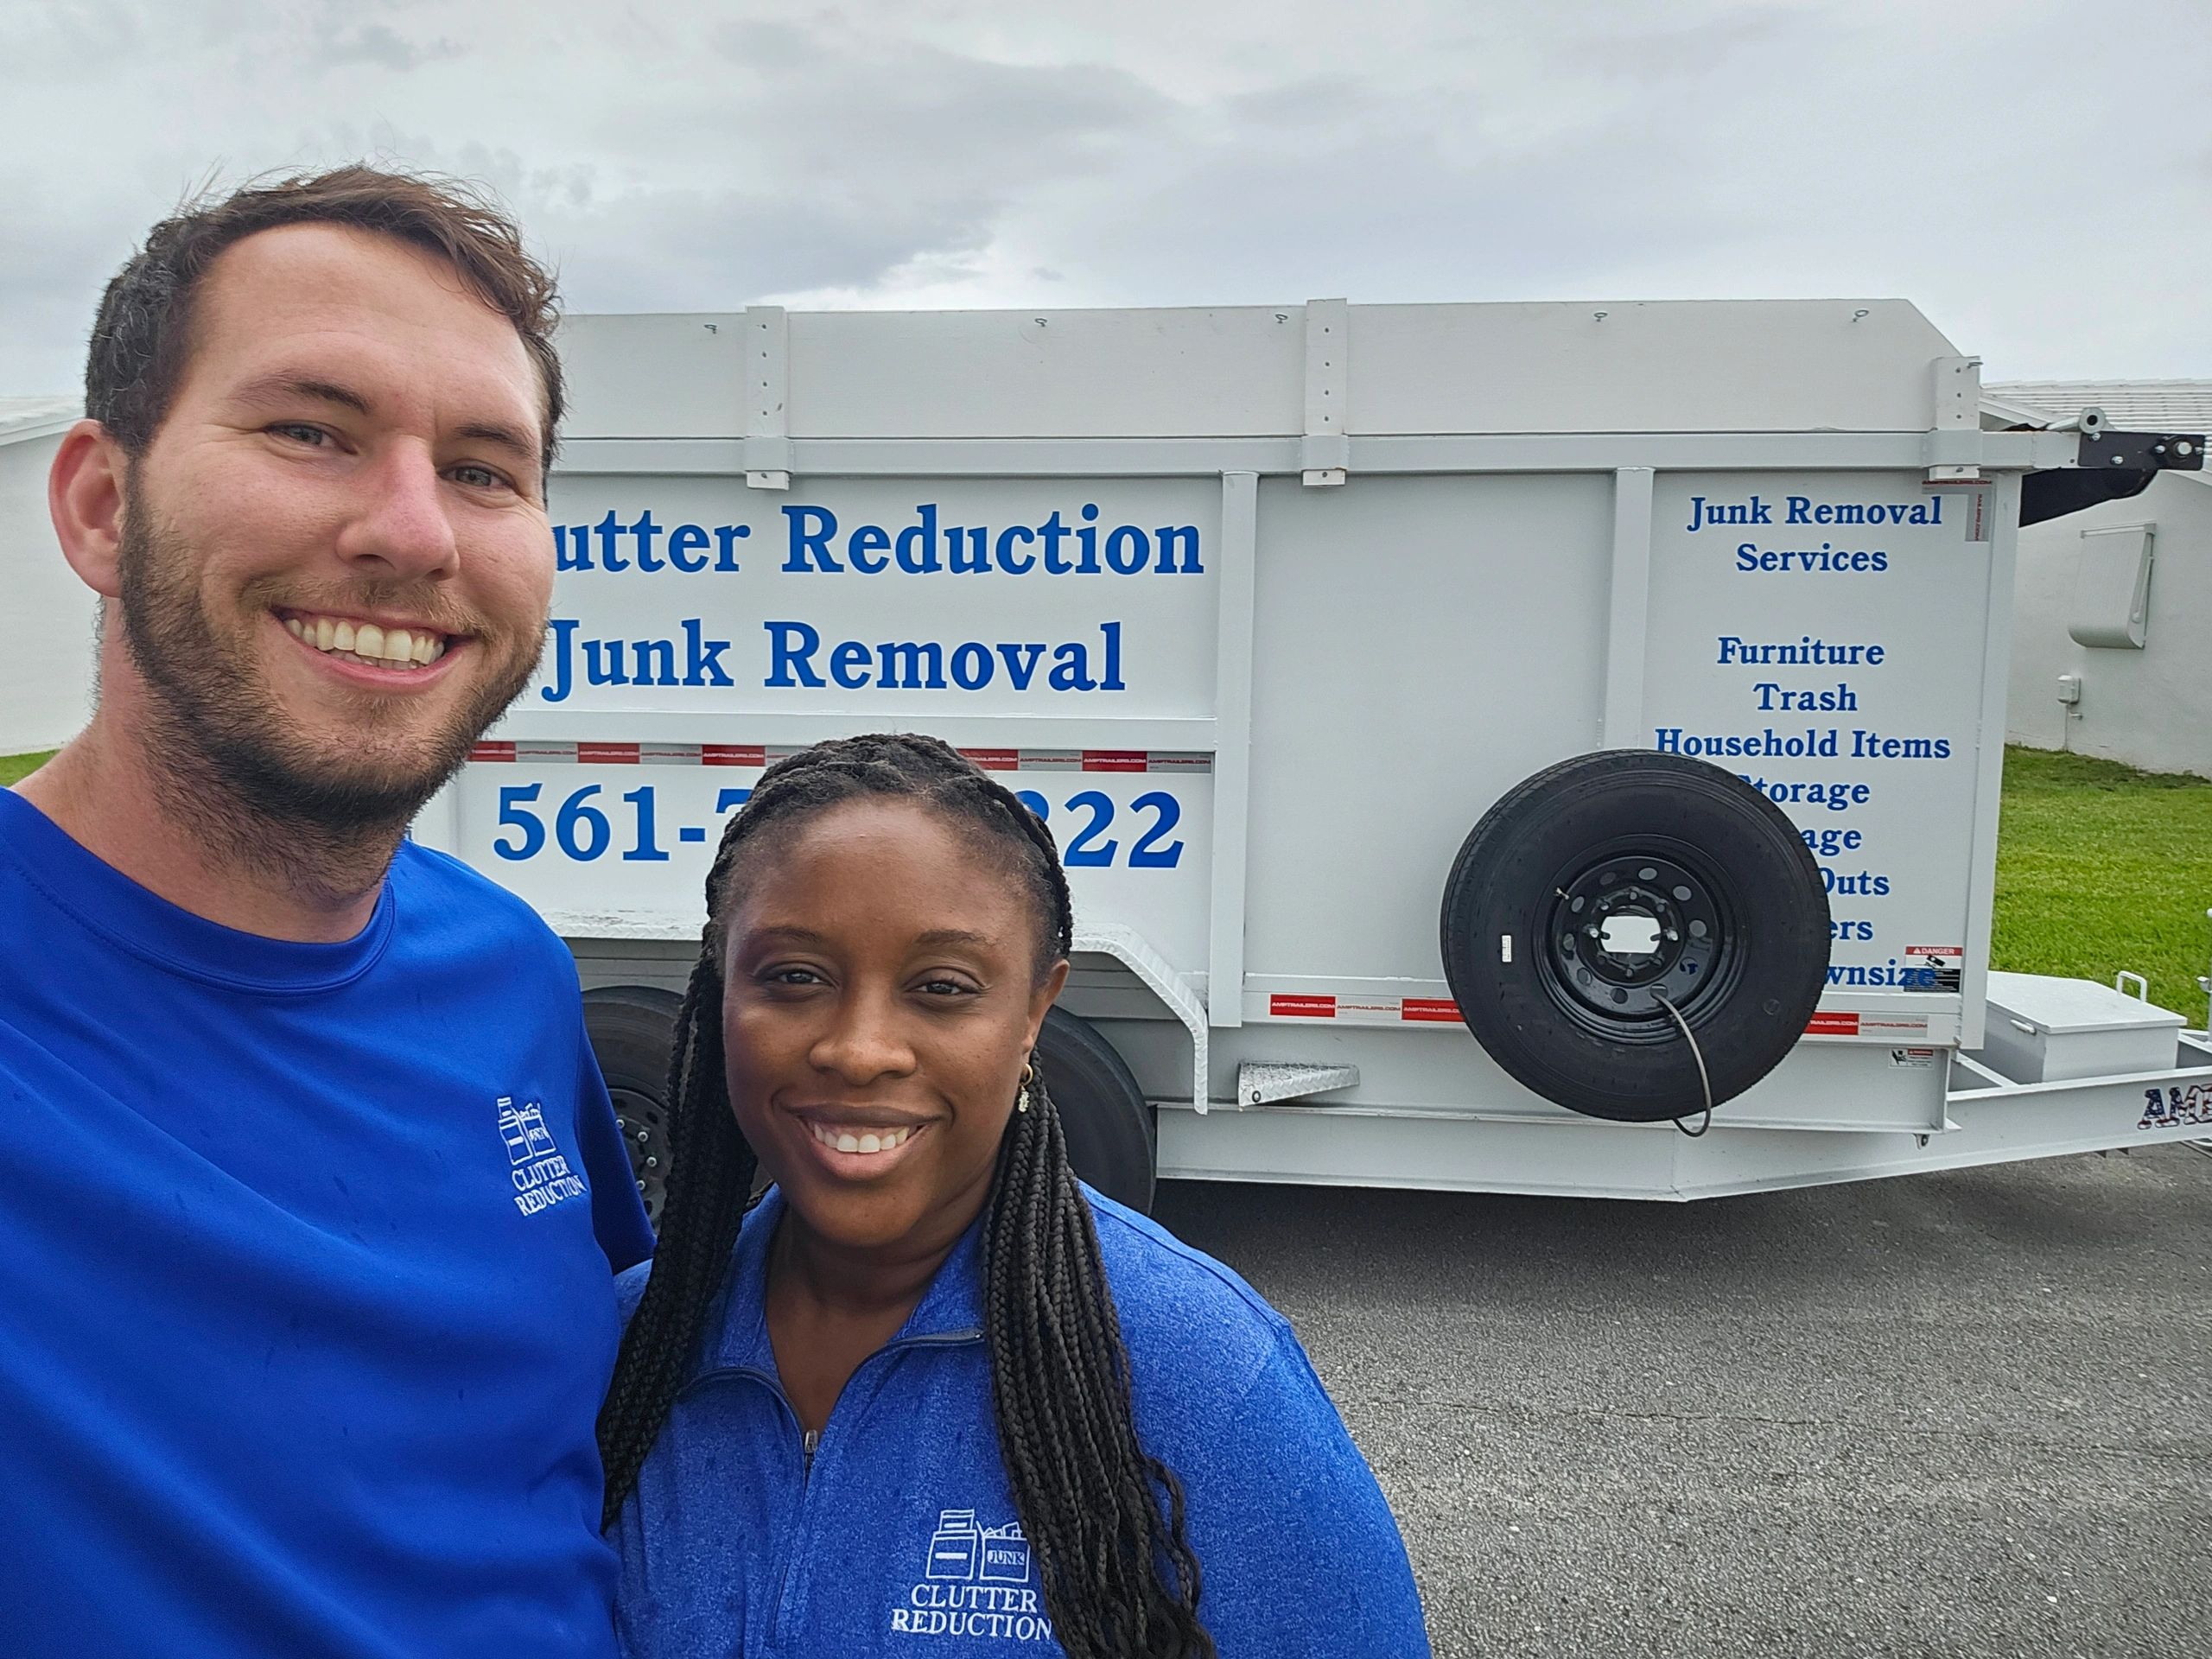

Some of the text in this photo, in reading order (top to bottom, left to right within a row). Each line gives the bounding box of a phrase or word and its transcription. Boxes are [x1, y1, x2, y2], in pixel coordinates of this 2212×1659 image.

[1687, 495, 1942, 532] Junk Removal
[551, 503, 1205, 575] utter Reduction
[1736, 542, 1889, 573] Services
[540, 618, 1127, 703] Junk Removal
[1717, 635, 1886, 666] Furniture
[1752, 683, 1859, 712] Trash
[1655, 728, 1951, 760] Household Items
[1738, 774, 1871, 811] torage
[1800, 829, 1863, 857] age
[1825, 958, 1937, 988] wnsize
[512, 1154, 571, 1192] CLUTTER
[513, 1174, 588, 1217] REDUCTION
[987, 1549, 1026, 1565] JUNK
[911, 1583, 1038, 1613] CLUTTER
[891, 1607, 1052, 1641] REDUCTION
